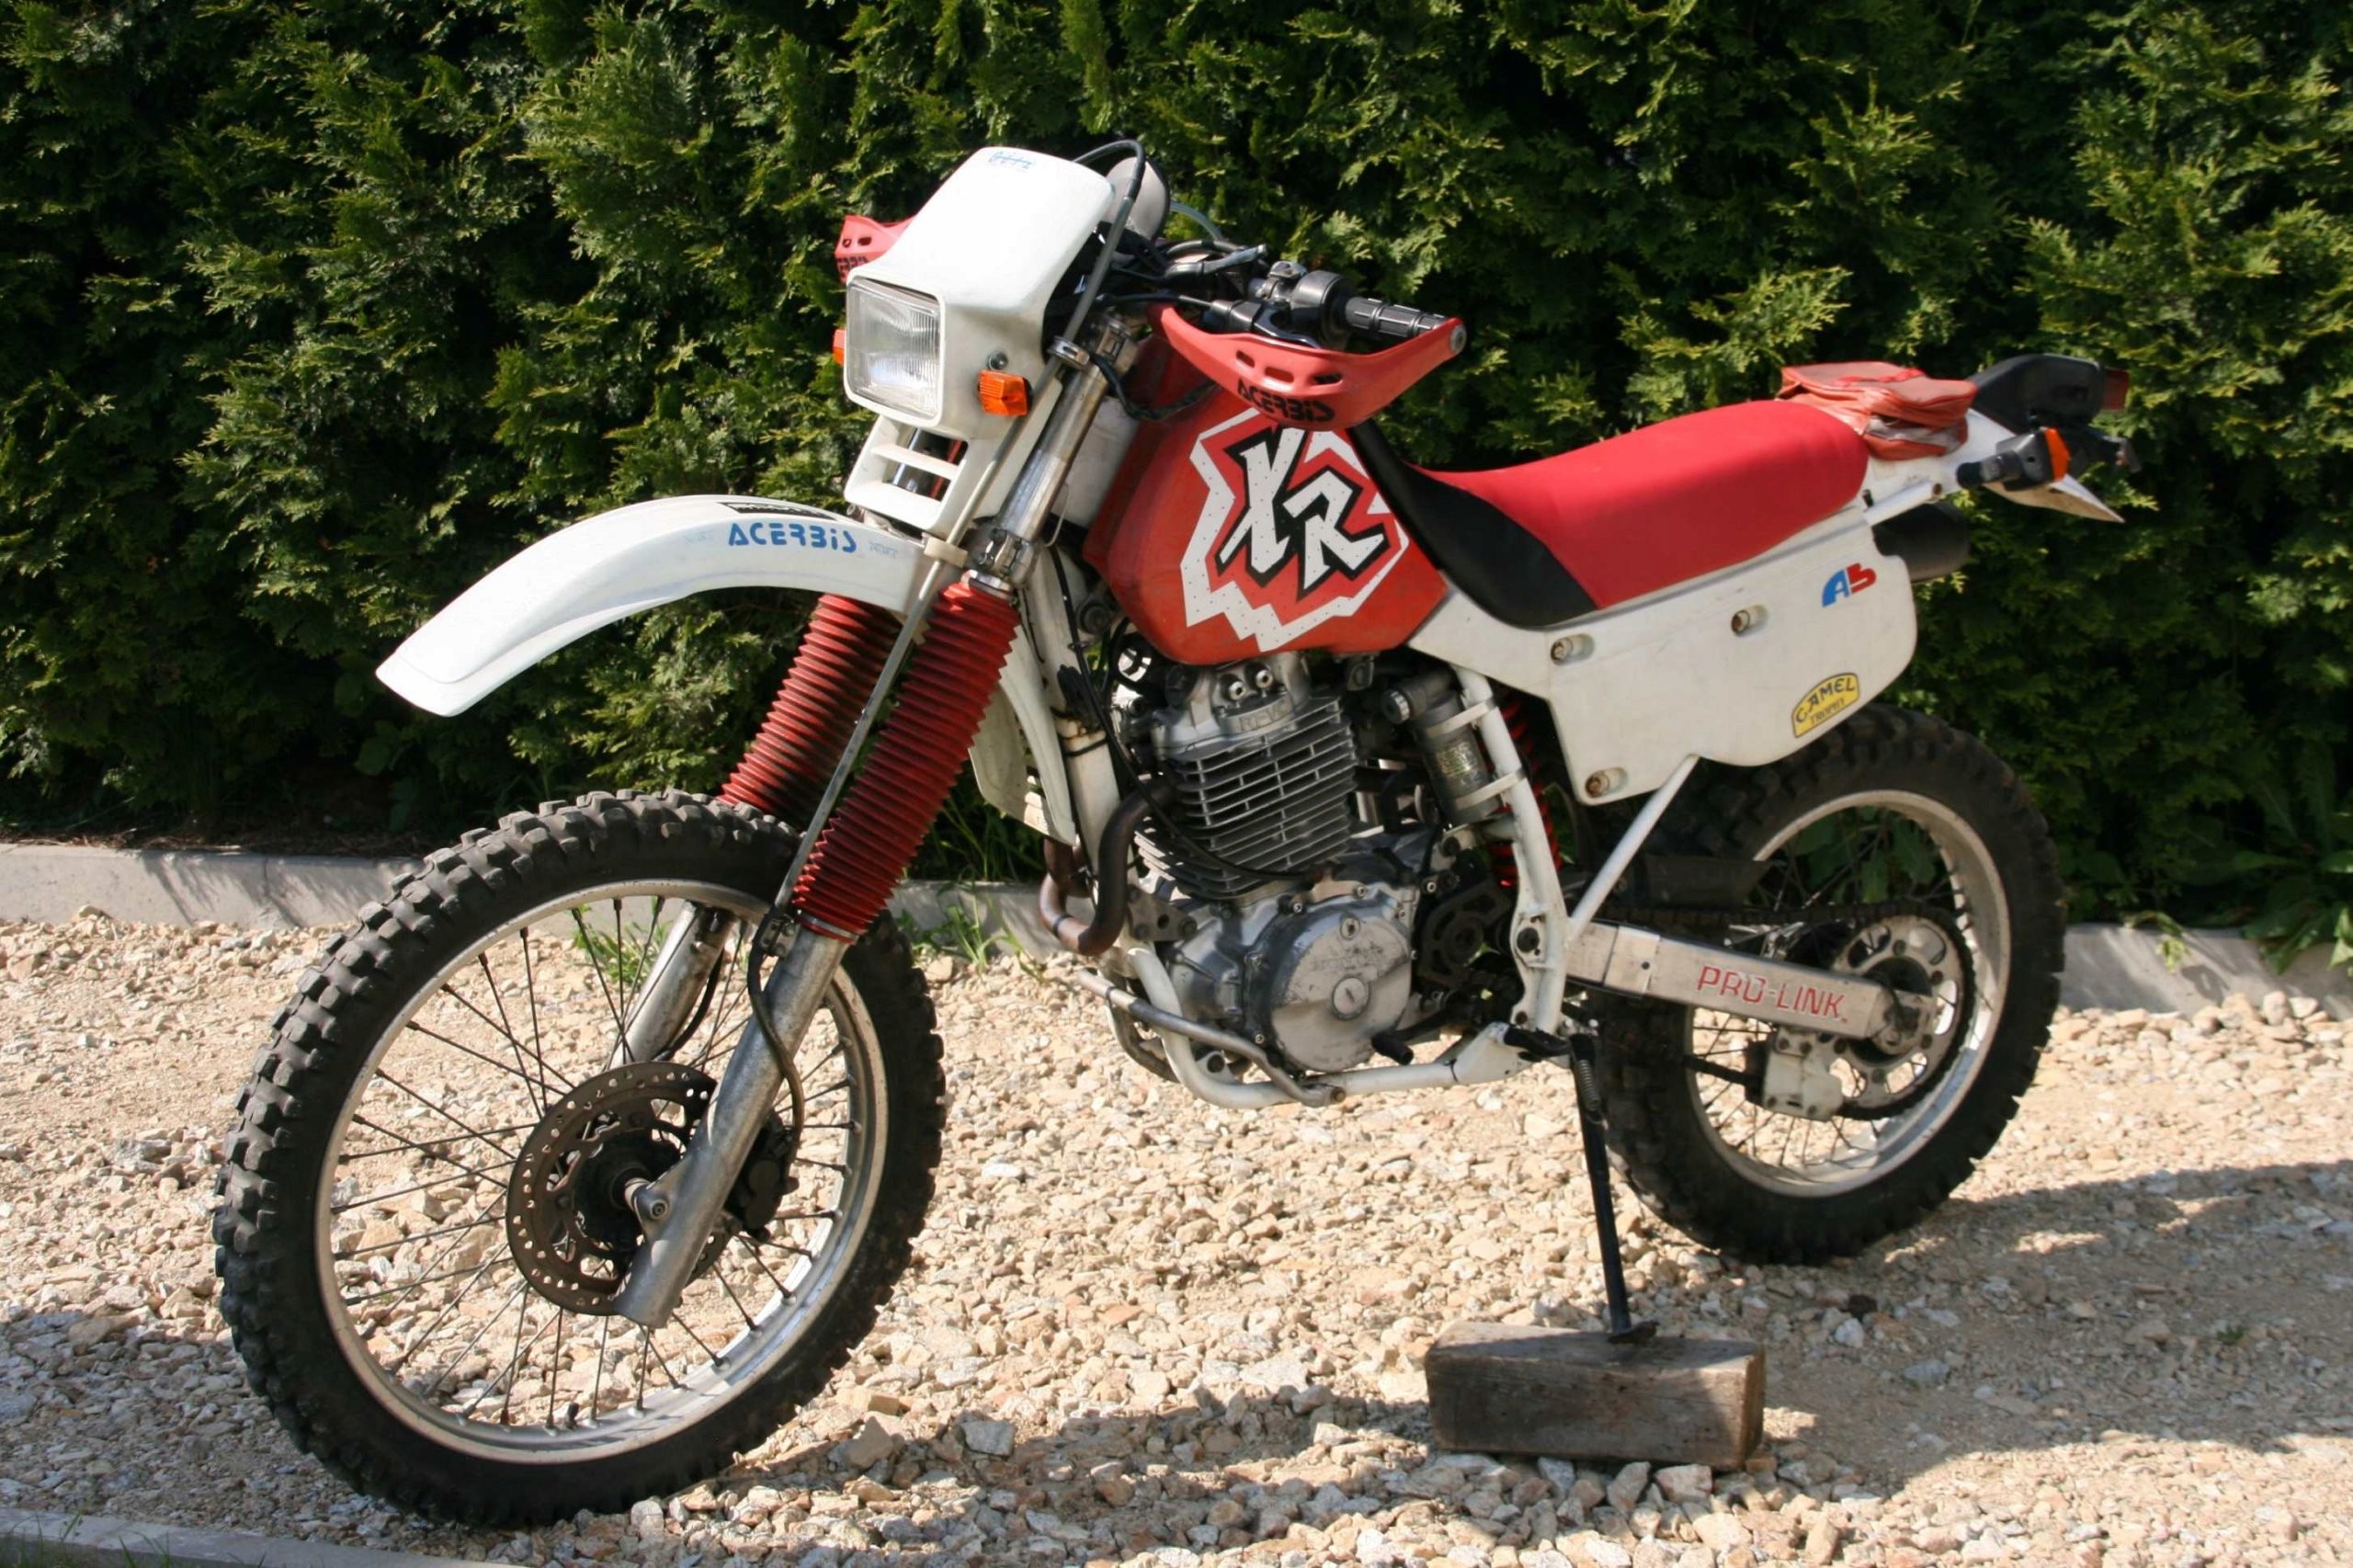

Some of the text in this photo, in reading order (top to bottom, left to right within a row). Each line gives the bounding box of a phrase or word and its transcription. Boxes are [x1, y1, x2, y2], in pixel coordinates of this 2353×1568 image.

[1215, 426, 1390, 600] XR
[1796, 677, 1855, 723] CAMEL
[1697, 966, 1844, 1018] PRO-LINK
